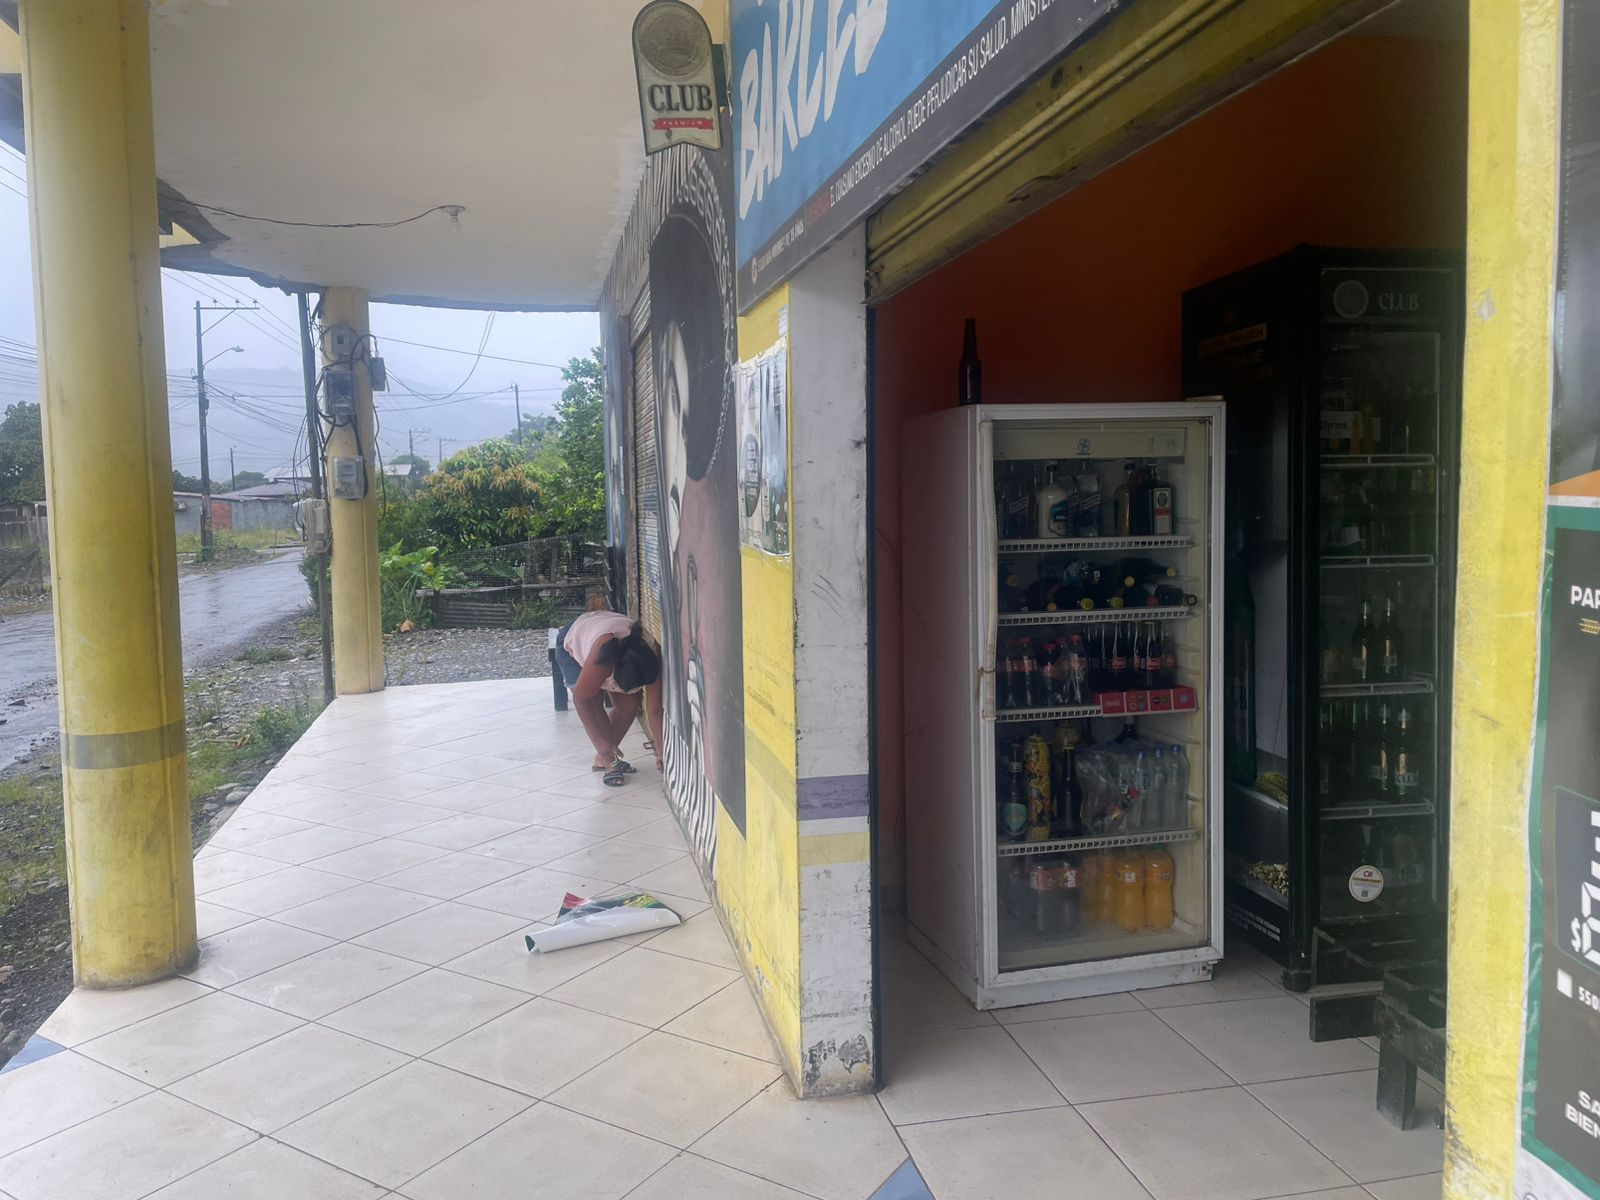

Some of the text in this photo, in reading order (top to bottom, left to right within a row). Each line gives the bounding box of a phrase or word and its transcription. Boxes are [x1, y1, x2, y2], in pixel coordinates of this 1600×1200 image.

[876, 137, 883, 166] DE
[883, 114, 907, 157] ALCOHOL
[906, 94, 927, 137] PUEDE
[926, 55, 968, 119] PERJUDICAR
[967, 44, 979, 80] SU
[979, 16, 1008, 69] SALUD.
[1010, 0, 1054, 40] MINIS
[647, 84, 713, 113] CLUB
[1378, 291, 1419, 311] CLUB
[1578, 985, 1600, 1014] 550
